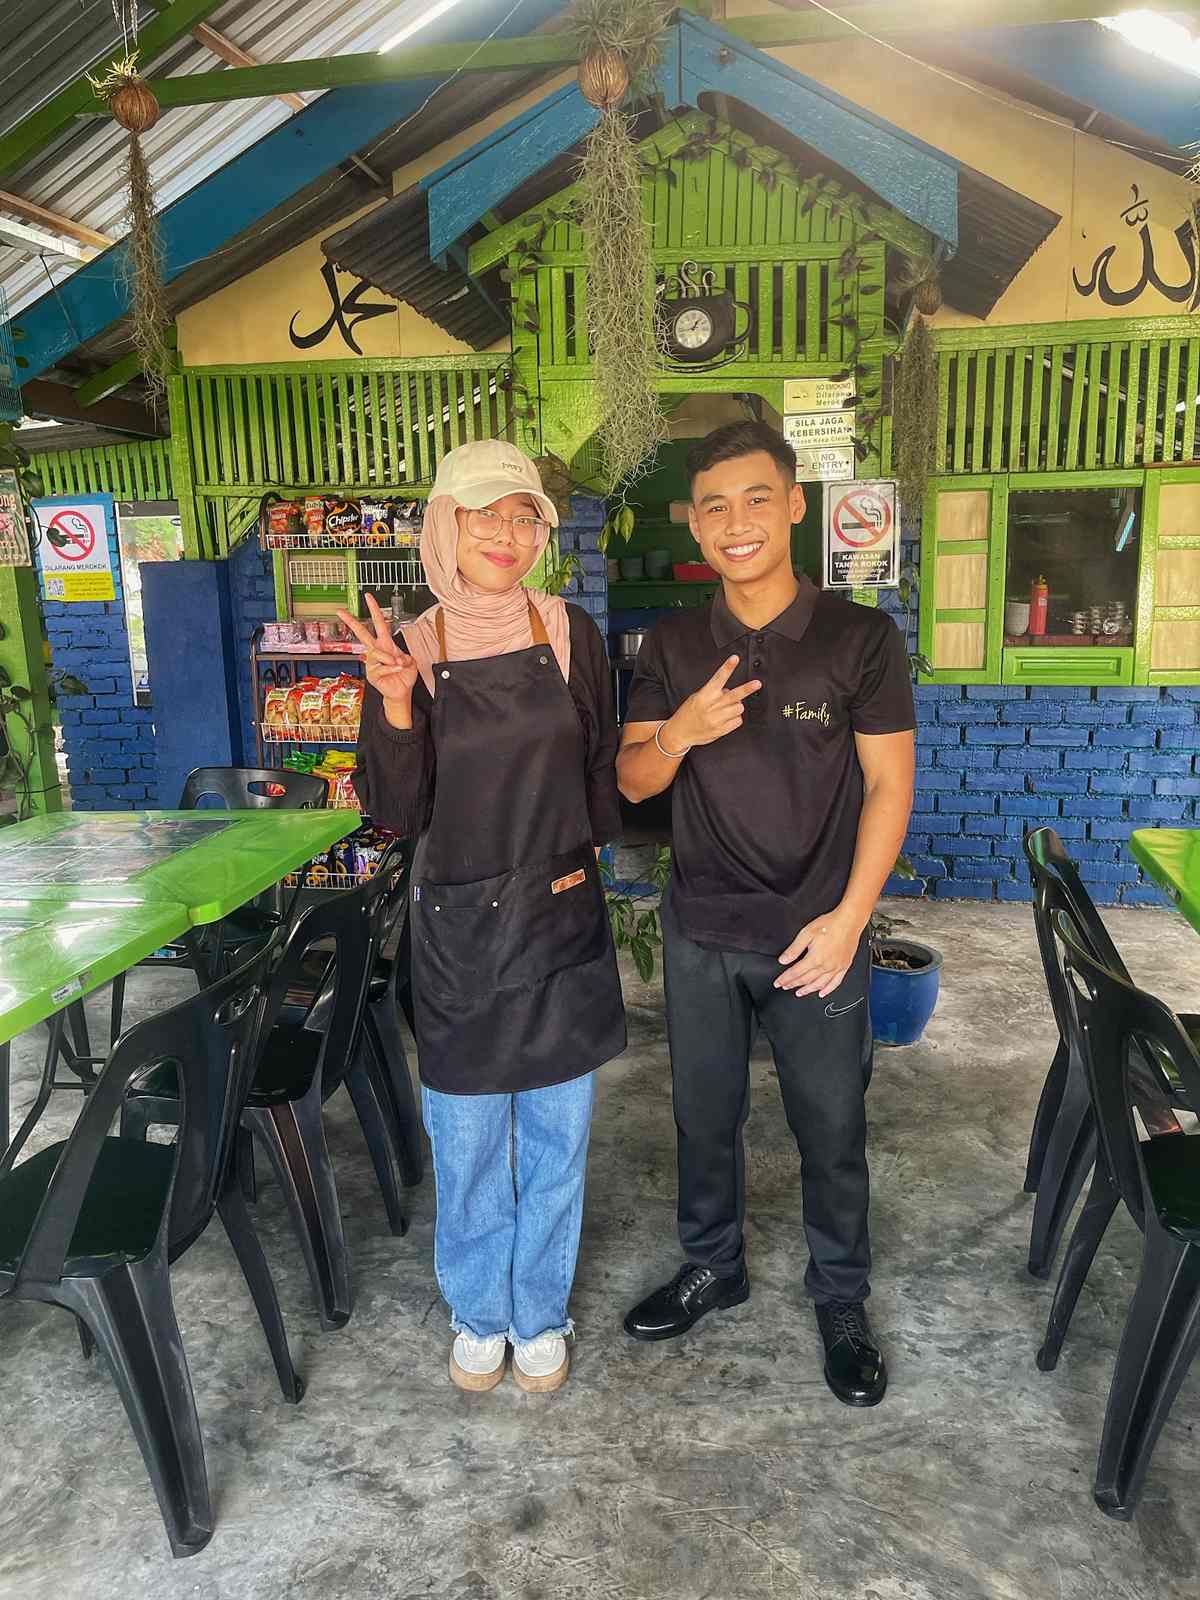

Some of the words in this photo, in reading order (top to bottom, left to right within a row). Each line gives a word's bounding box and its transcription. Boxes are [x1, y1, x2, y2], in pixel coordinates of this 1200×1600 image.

[795, 418, 816, 427] SILA
[819, 416, 844, 425] JAGA
[790, 427, 851, 438] KEBERSIHAN
[821, 453, 836, 461] NO
[812, 460, 844, 471] ENTRY
[328, 513, 359, 528] Chipster
[842, 552, 880, 560] KAWASAN
[44, 563, 75, 571] DILARANG
[76, 562, 107, 570] MEROKOK
